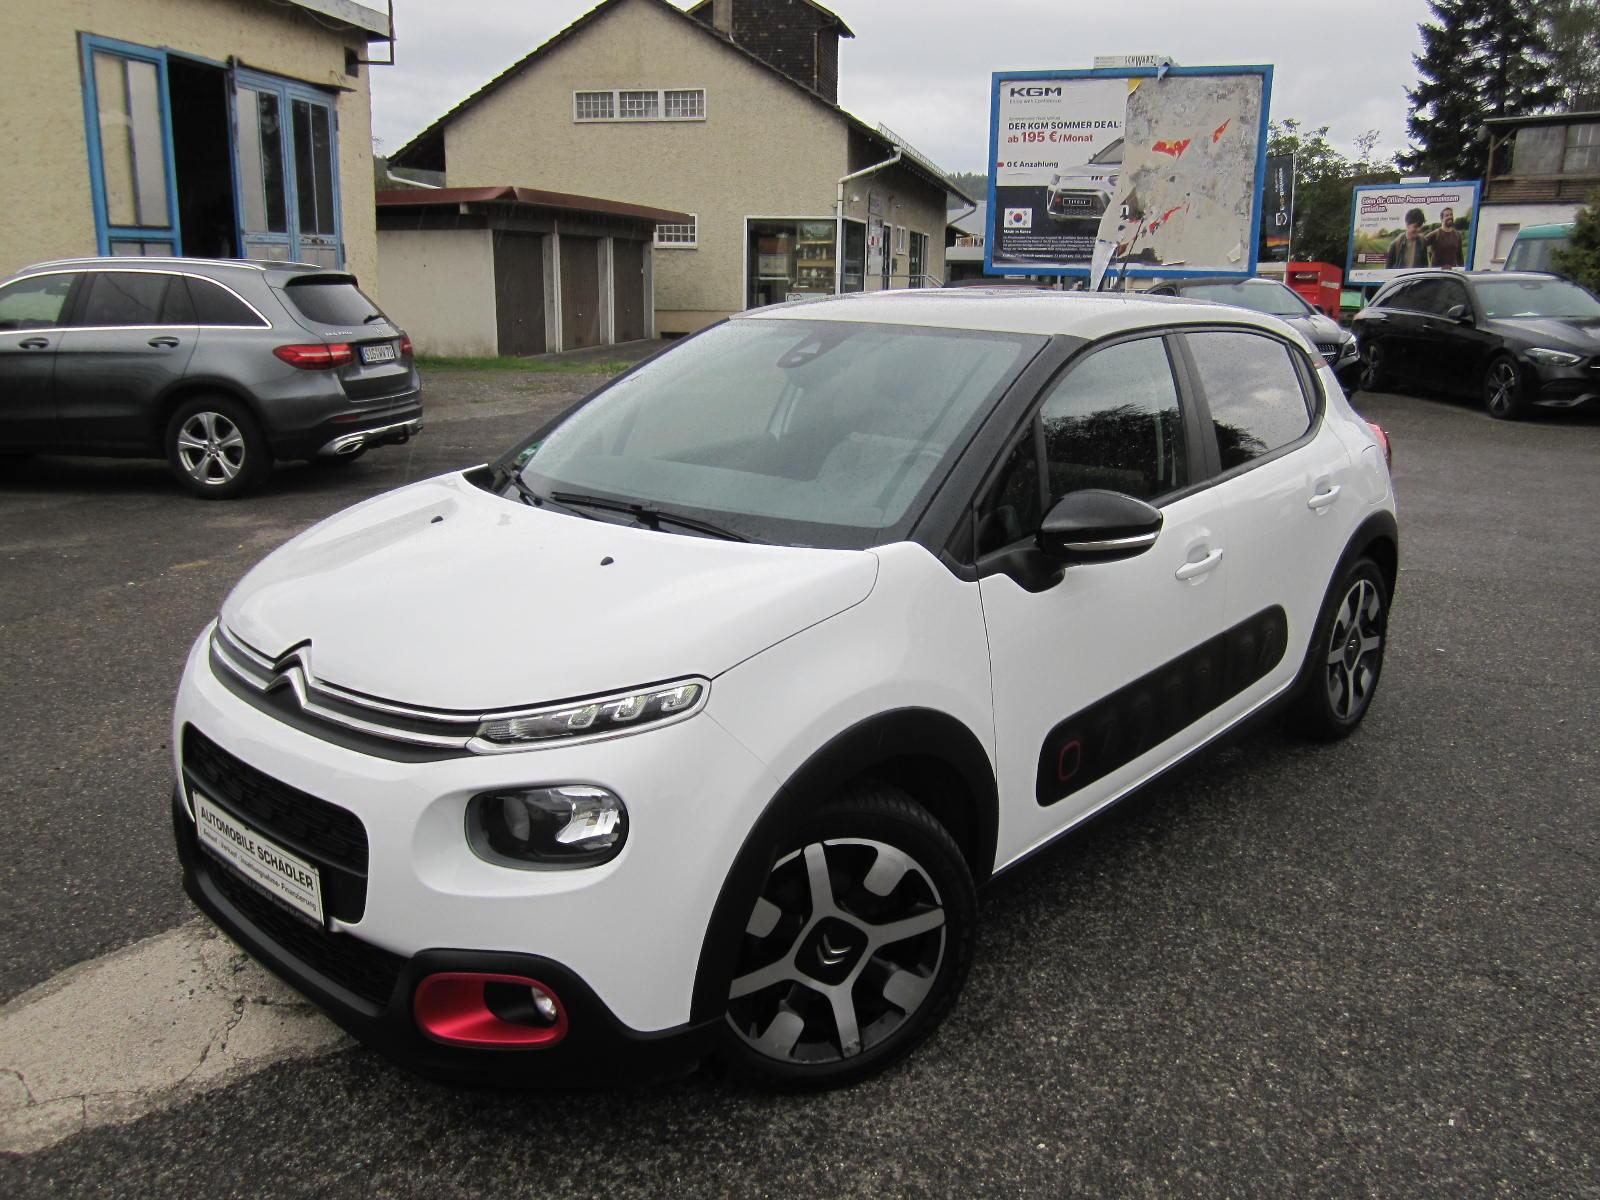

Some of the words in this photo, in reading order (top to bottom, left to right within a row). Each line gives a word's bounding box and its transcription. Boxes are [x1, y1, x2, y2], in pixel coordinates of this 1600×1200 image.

[1010, 87, 1062, 97] KGM
[1008, 122, 1026, 130] DER
[1028, 122, 1049, 130] KGM
[1051, 121, 1092, 129] SOMMER
[1094, 120, 1122, 129] DEAL:
[1007, 135, 1019, 143] ab
[1021, 131, 1046, 143] 195
[201, 807, 255, 854] AUTOMOBILE
